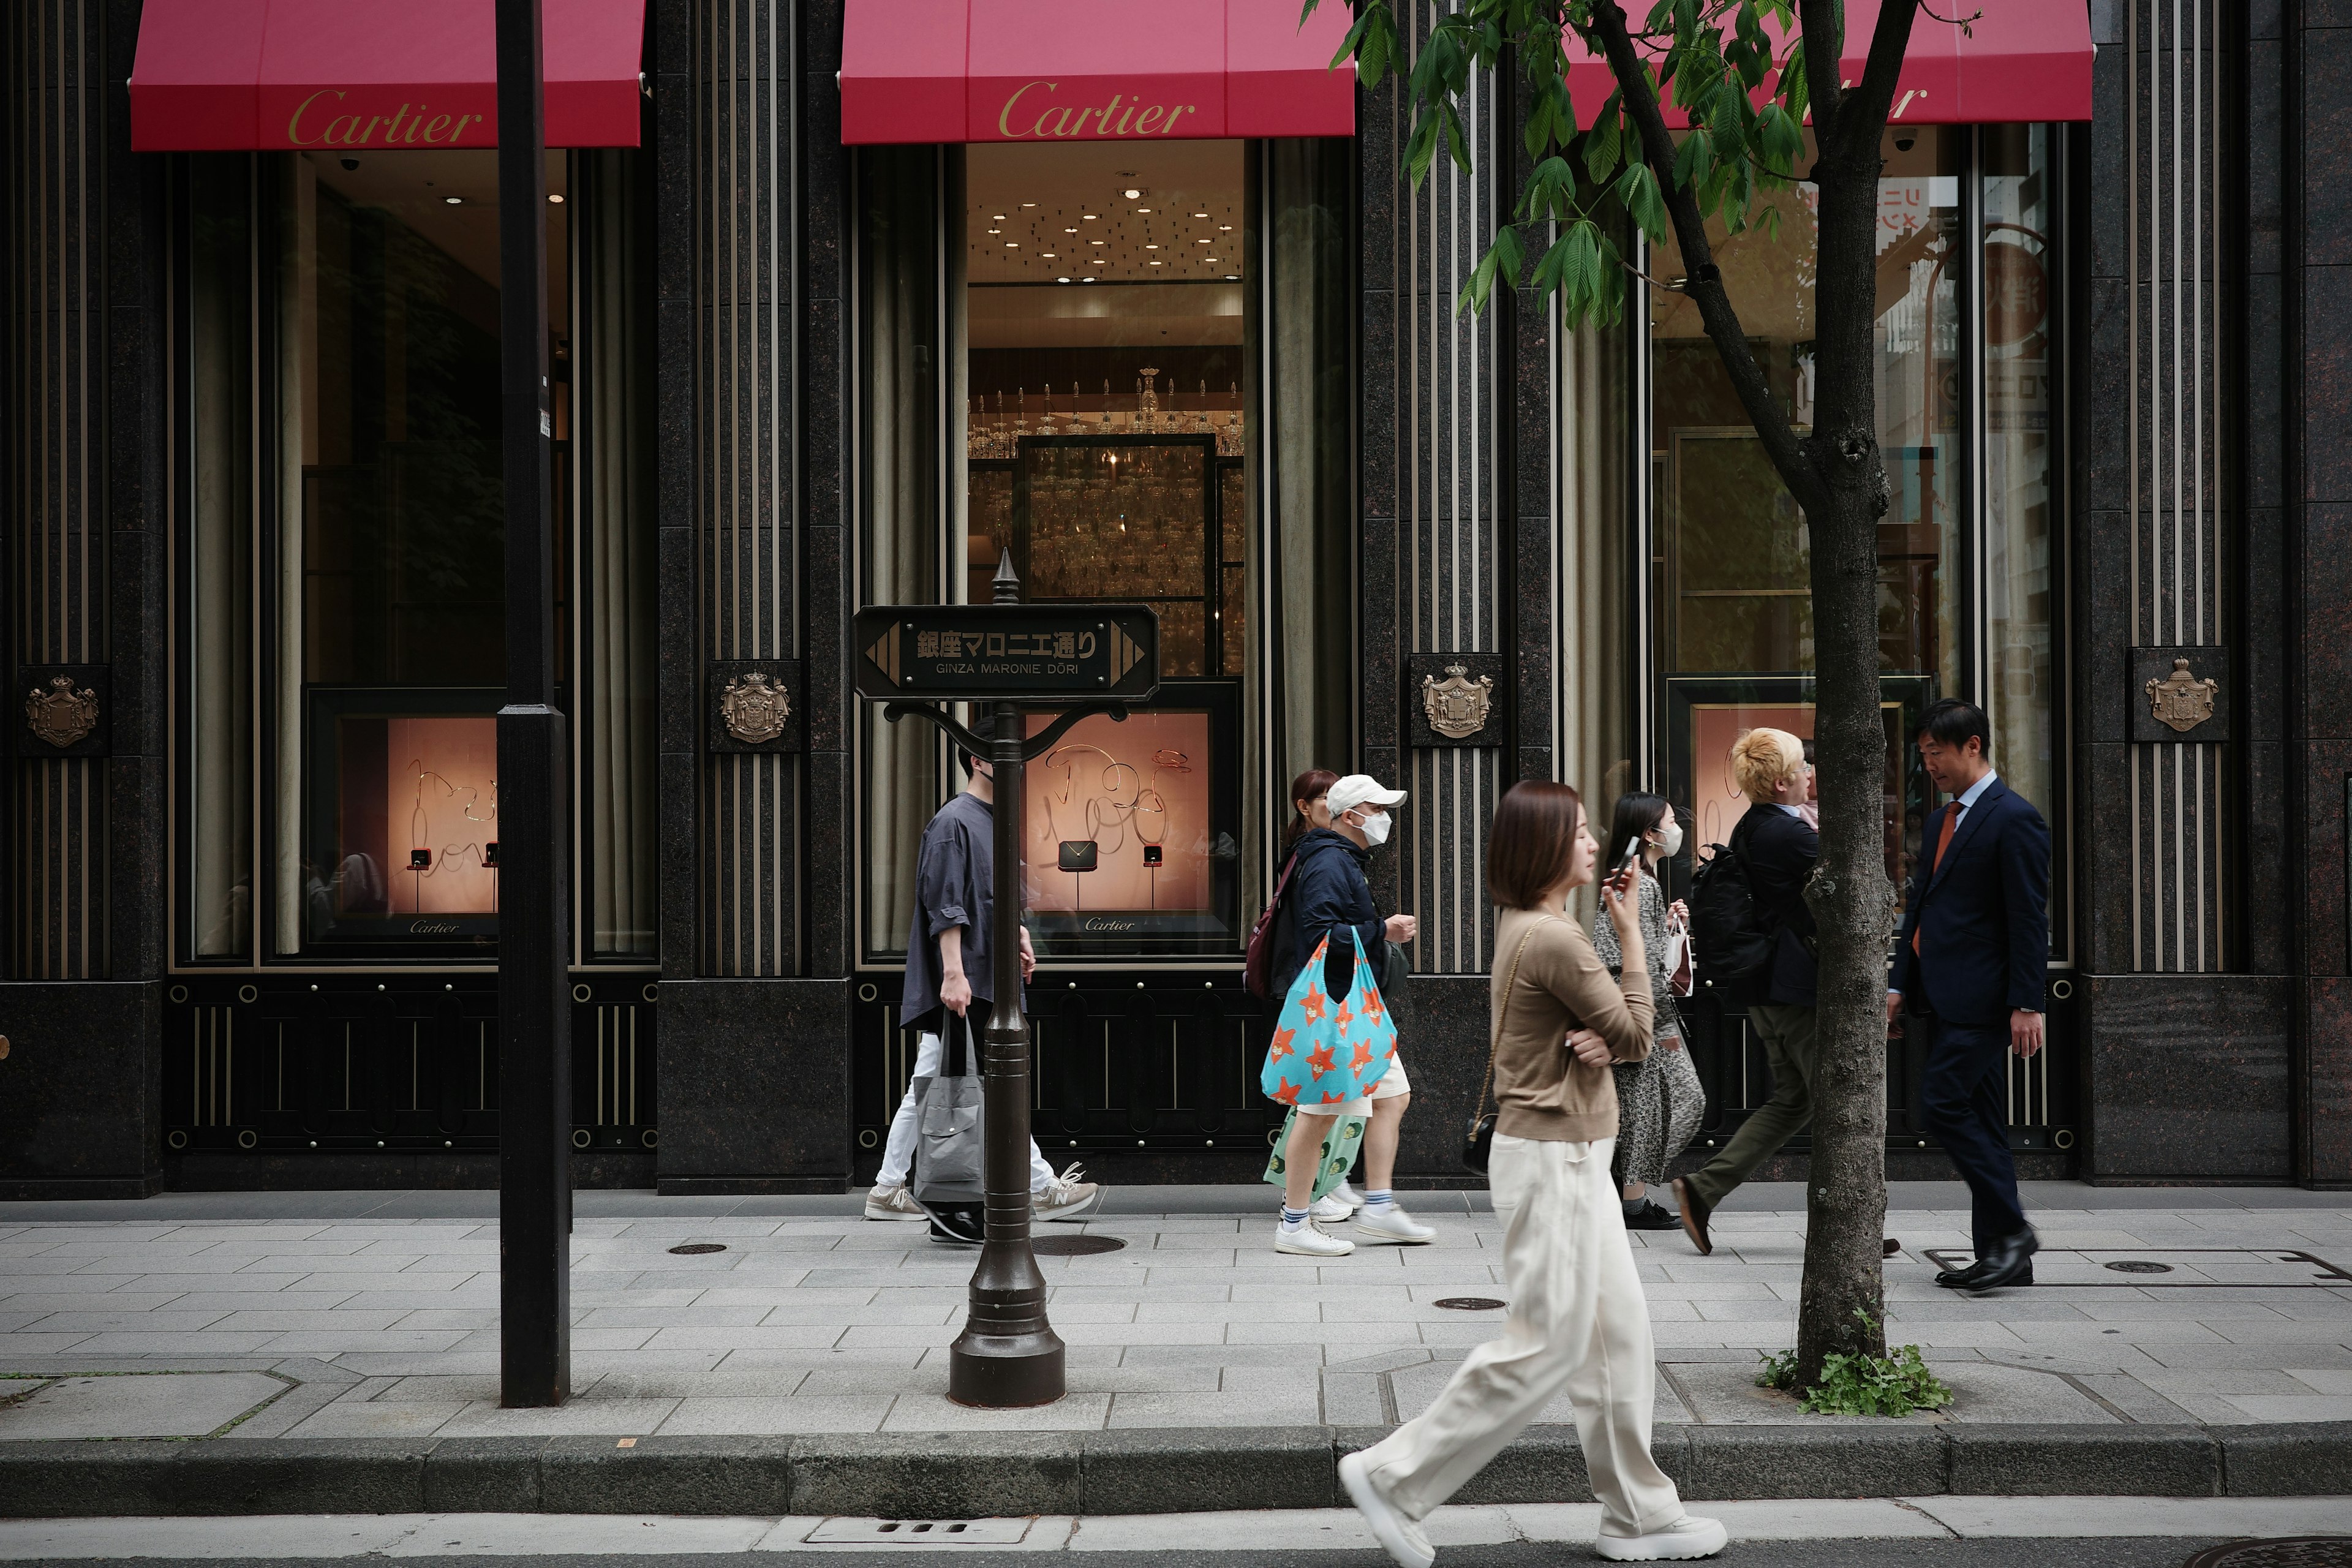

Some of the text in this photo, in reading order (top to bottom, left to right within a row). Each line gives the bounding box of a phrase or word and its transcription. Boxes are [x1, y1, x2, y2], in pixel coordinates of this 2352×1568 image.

[999, 81, 1195, 137] Cartier
[288, 89, 482, 145] Cartier
[917, 630, 1096, 659] 銀座マロニエ通り
[936, 663, 974, 674] GINZA
[981, 663, 1040, 674] MARONIE
[410, 920, 459, 934] Cartier
[1085, 917, 1134, 932] Cartier
[1054, 1193, 1069, 1205] N
